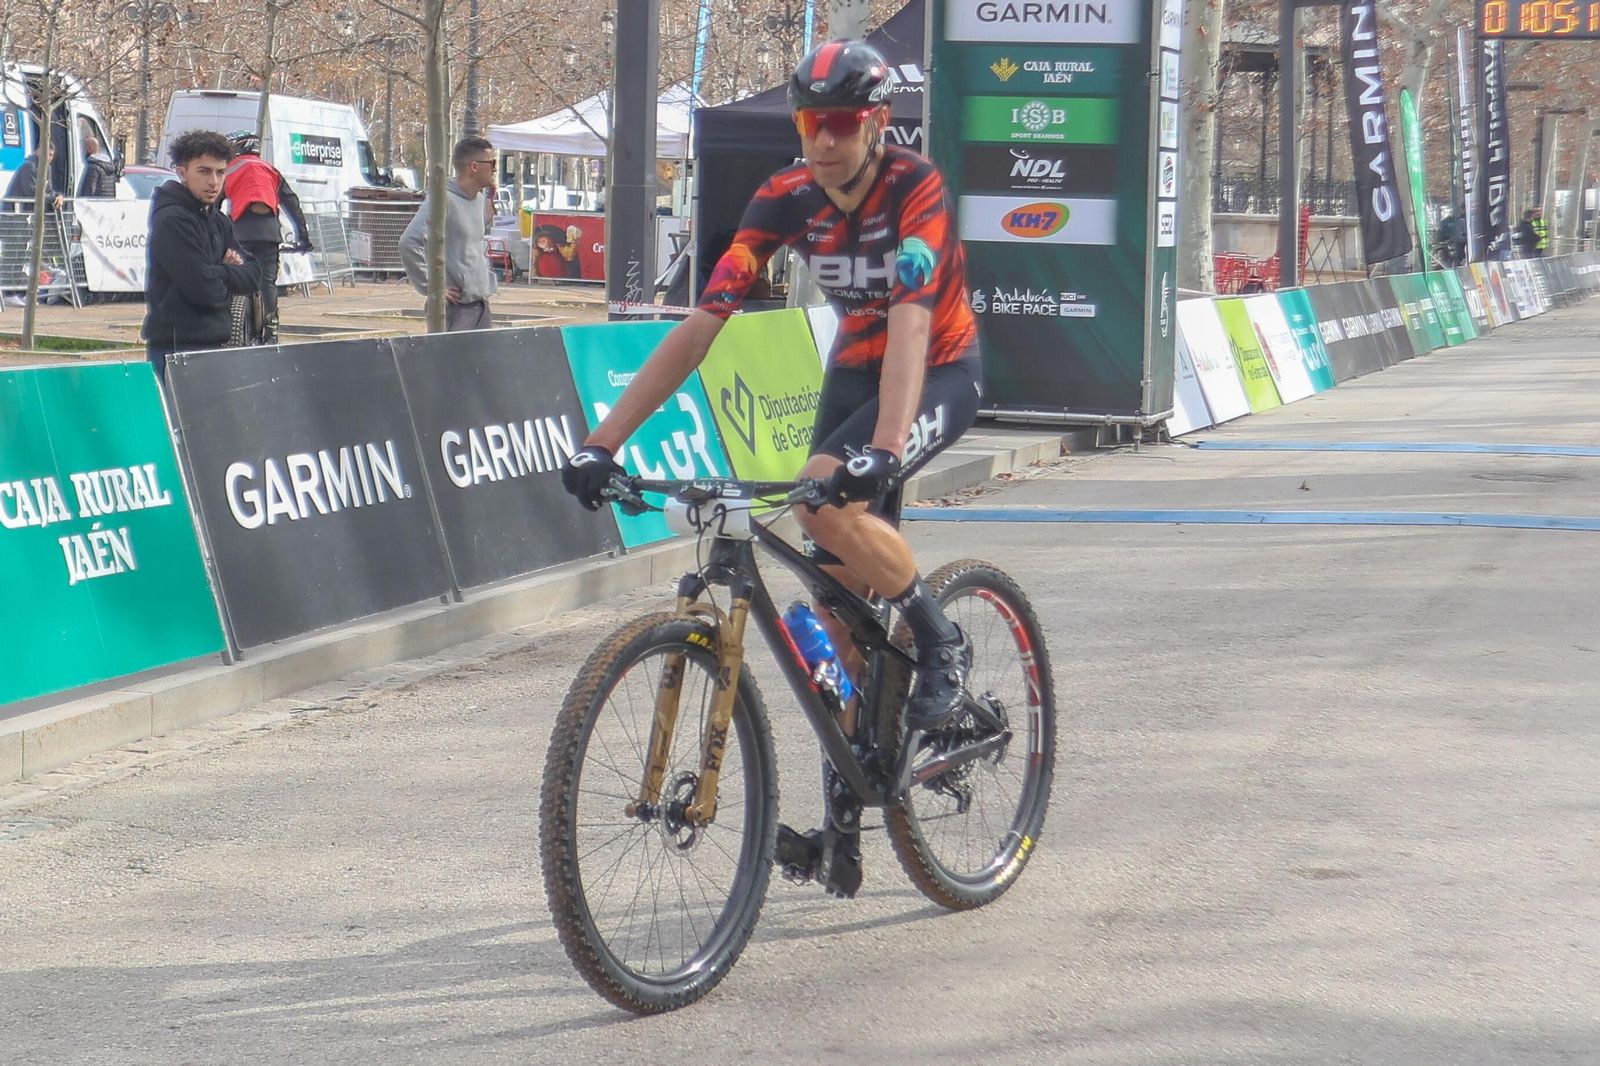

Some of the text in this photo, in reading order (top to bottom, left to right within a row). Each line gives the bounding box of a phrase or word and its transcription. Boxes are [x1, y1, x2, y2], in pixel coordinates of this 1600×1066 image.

[976, 3, 1107, 24] GARMIN
[1023, 61, 1096, 73] CAJA RURAL
[1043, 72, 1073, 84] JAÉN
[1351, 5, 1396, 223] GARMIN
[291, 141, 342, 162] enterprise
[1010, 159, 1065, 178] NDL
[808, 249, 897, 289] BH
[992, 286, 1057, 304] Andalucía
[992, 302, 1059, 316] BIKE RACE
[772, 427, 789, 452] de
[439, 415, 576, 488] GARMIN
[225, 440, 404, 529] GARMIN
[0, 464, 172, 529] CAJA RURAL
[58, 522, 136, 586] JAÉN
